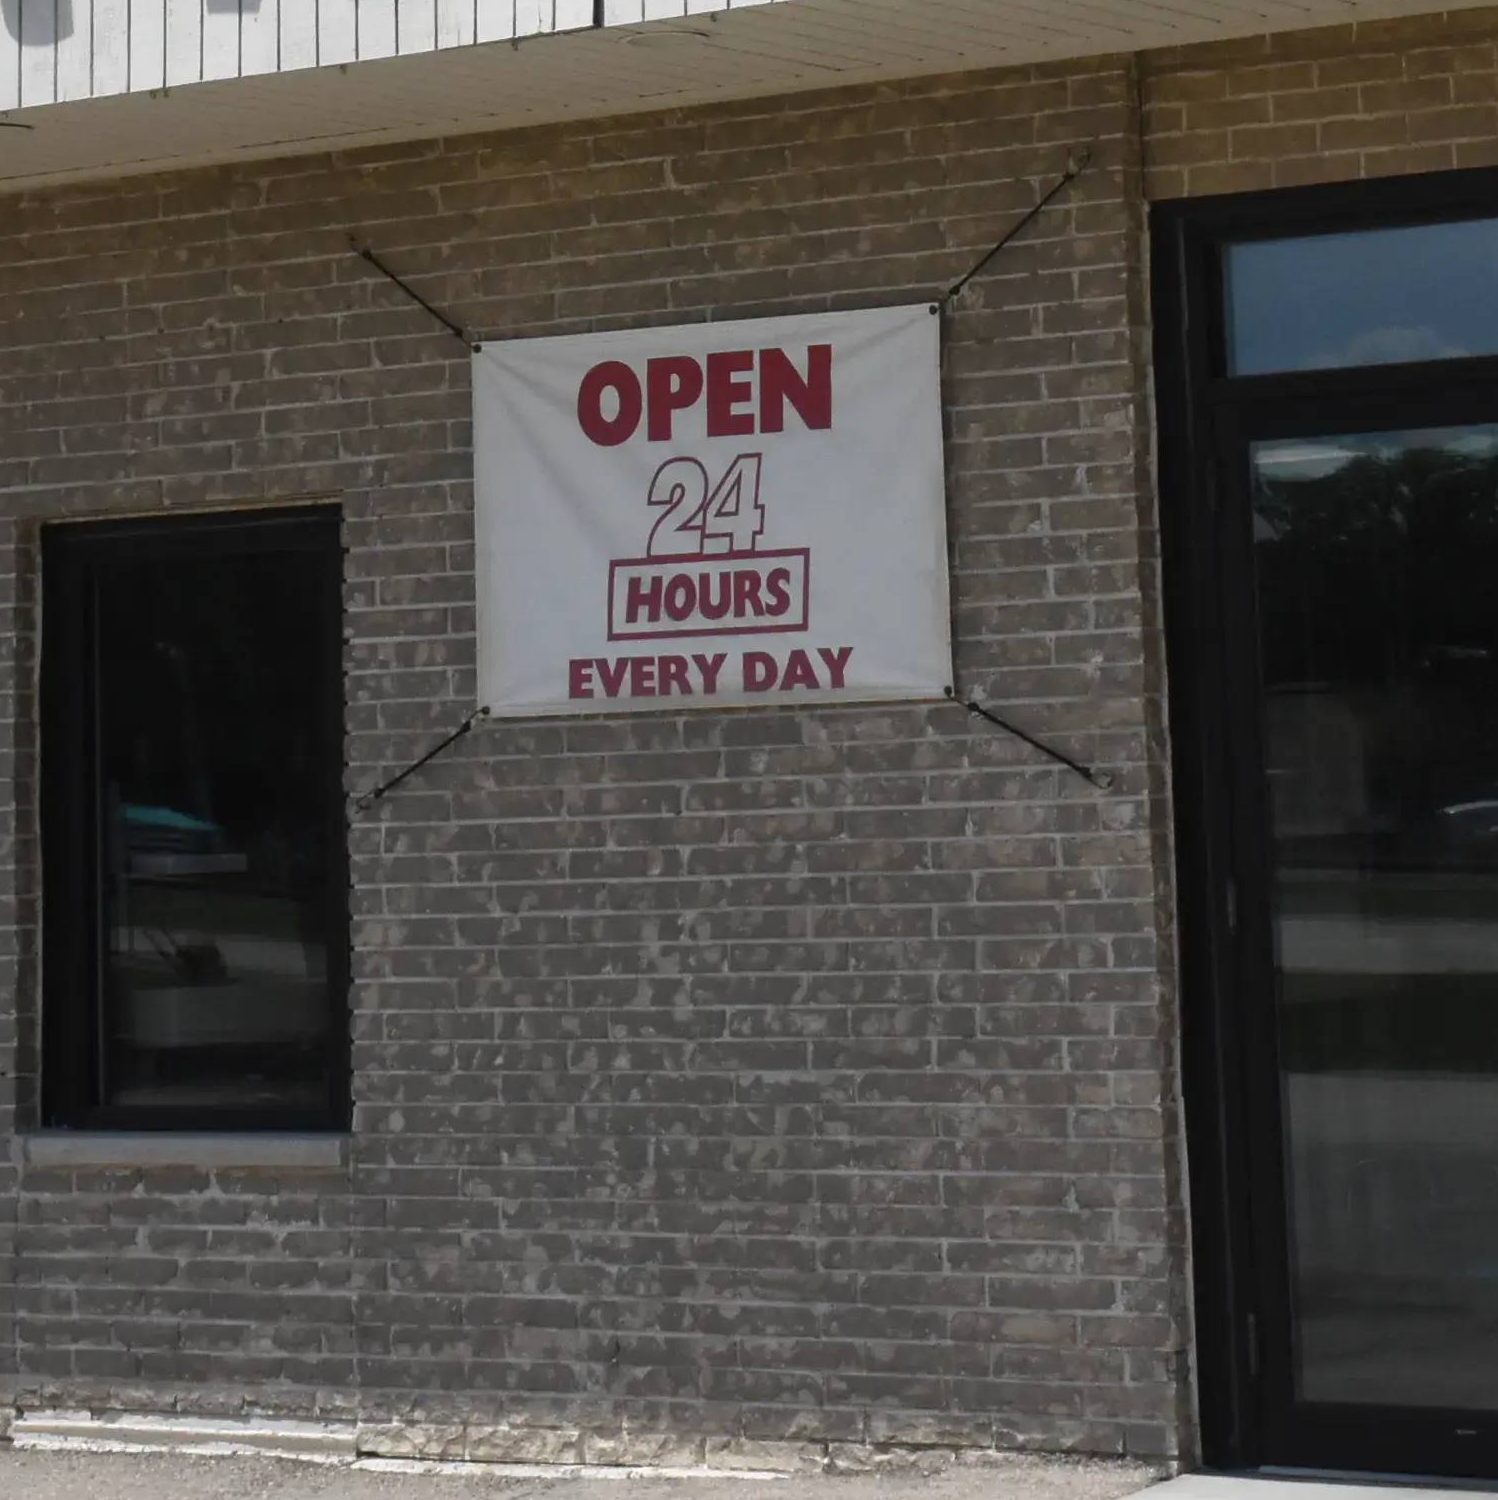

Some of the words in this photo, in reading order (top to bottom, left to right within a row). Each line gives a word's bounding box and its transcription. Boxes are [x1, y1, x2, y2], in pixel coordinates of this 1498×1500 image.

[577, 344, 832, 446] OPEN
[647, 452, 765, 558] 24
[625, 567, 791, 623] HOURS
[568, 652, 727, 699] EVERY
[742, 646, 853, 693] DAY
